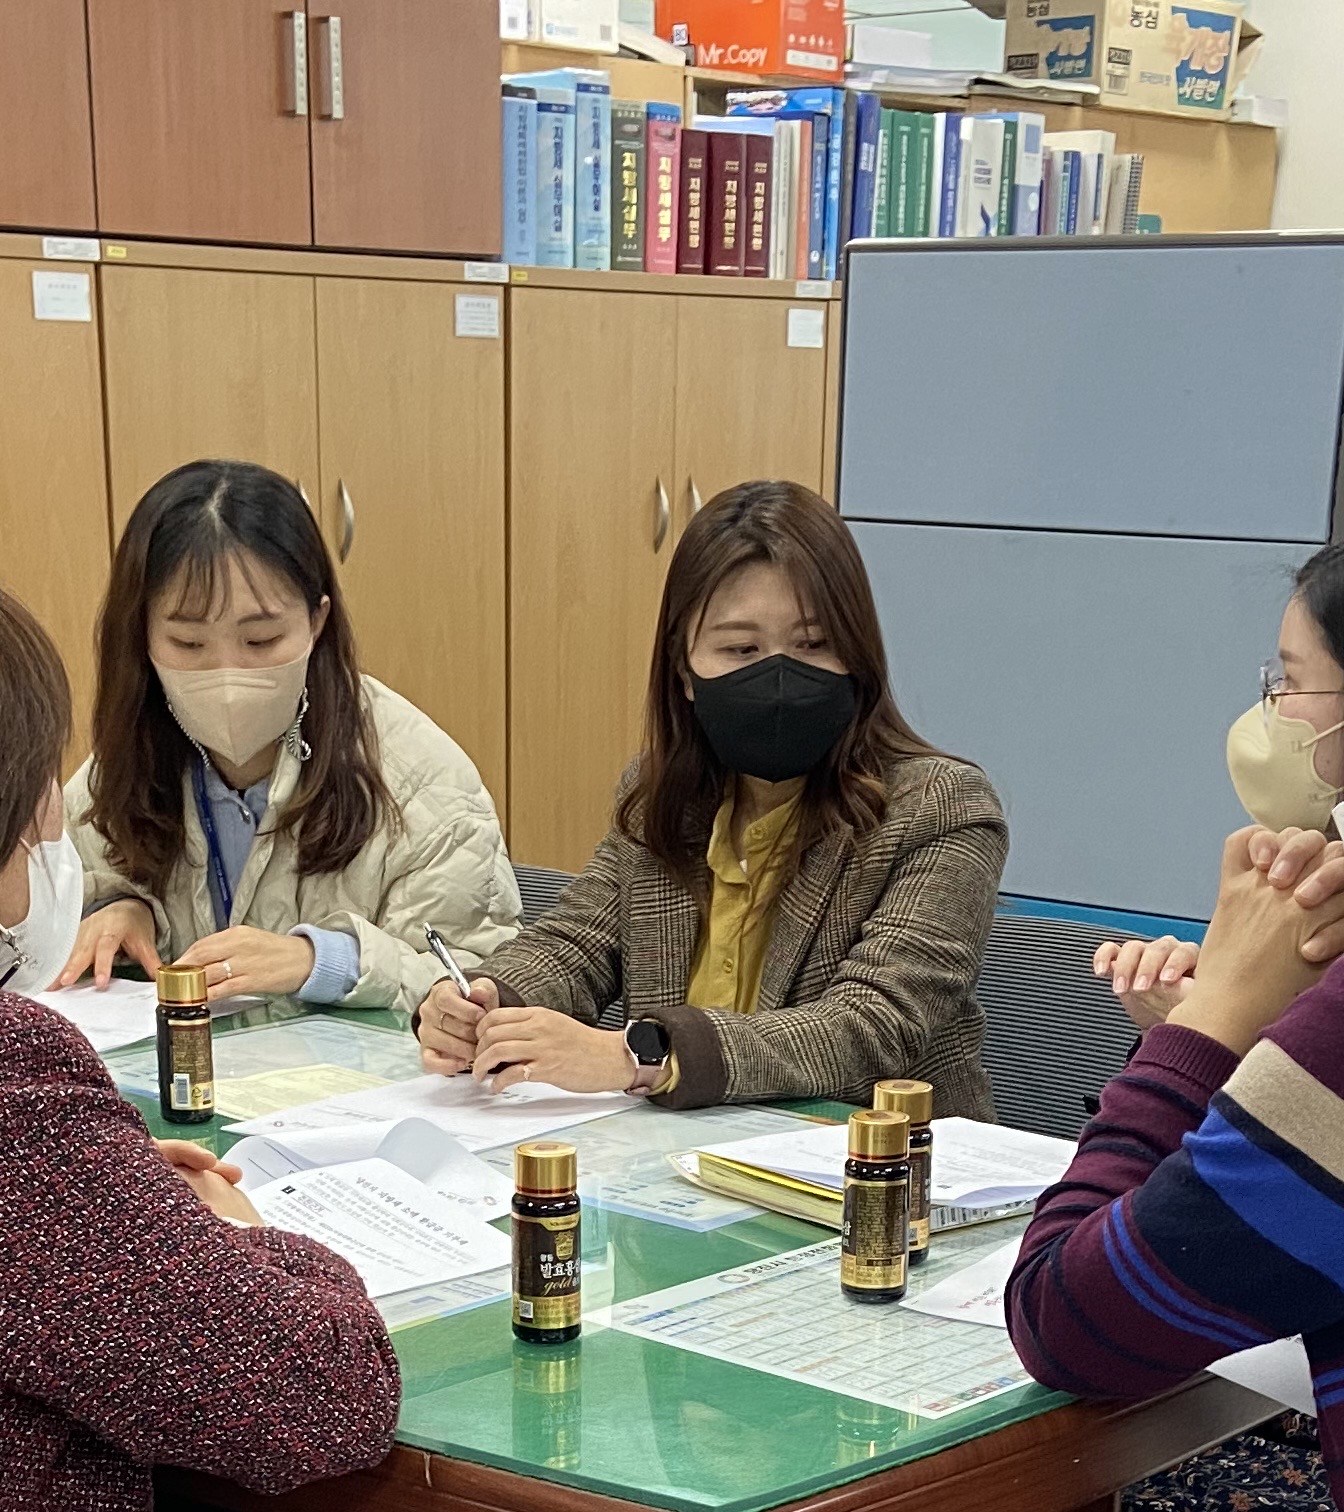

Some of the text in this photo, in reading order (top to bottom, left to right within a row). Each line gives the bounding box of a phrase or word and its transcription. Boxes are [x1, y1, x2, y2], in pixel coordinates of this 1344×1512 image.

[1131, 6, 1159, 29] 농심
[697, 43, 768, 67] Mr.Copy
[1177, 76, 1221, 102] 사발면
[543, 1277, 572, 1296] gold
